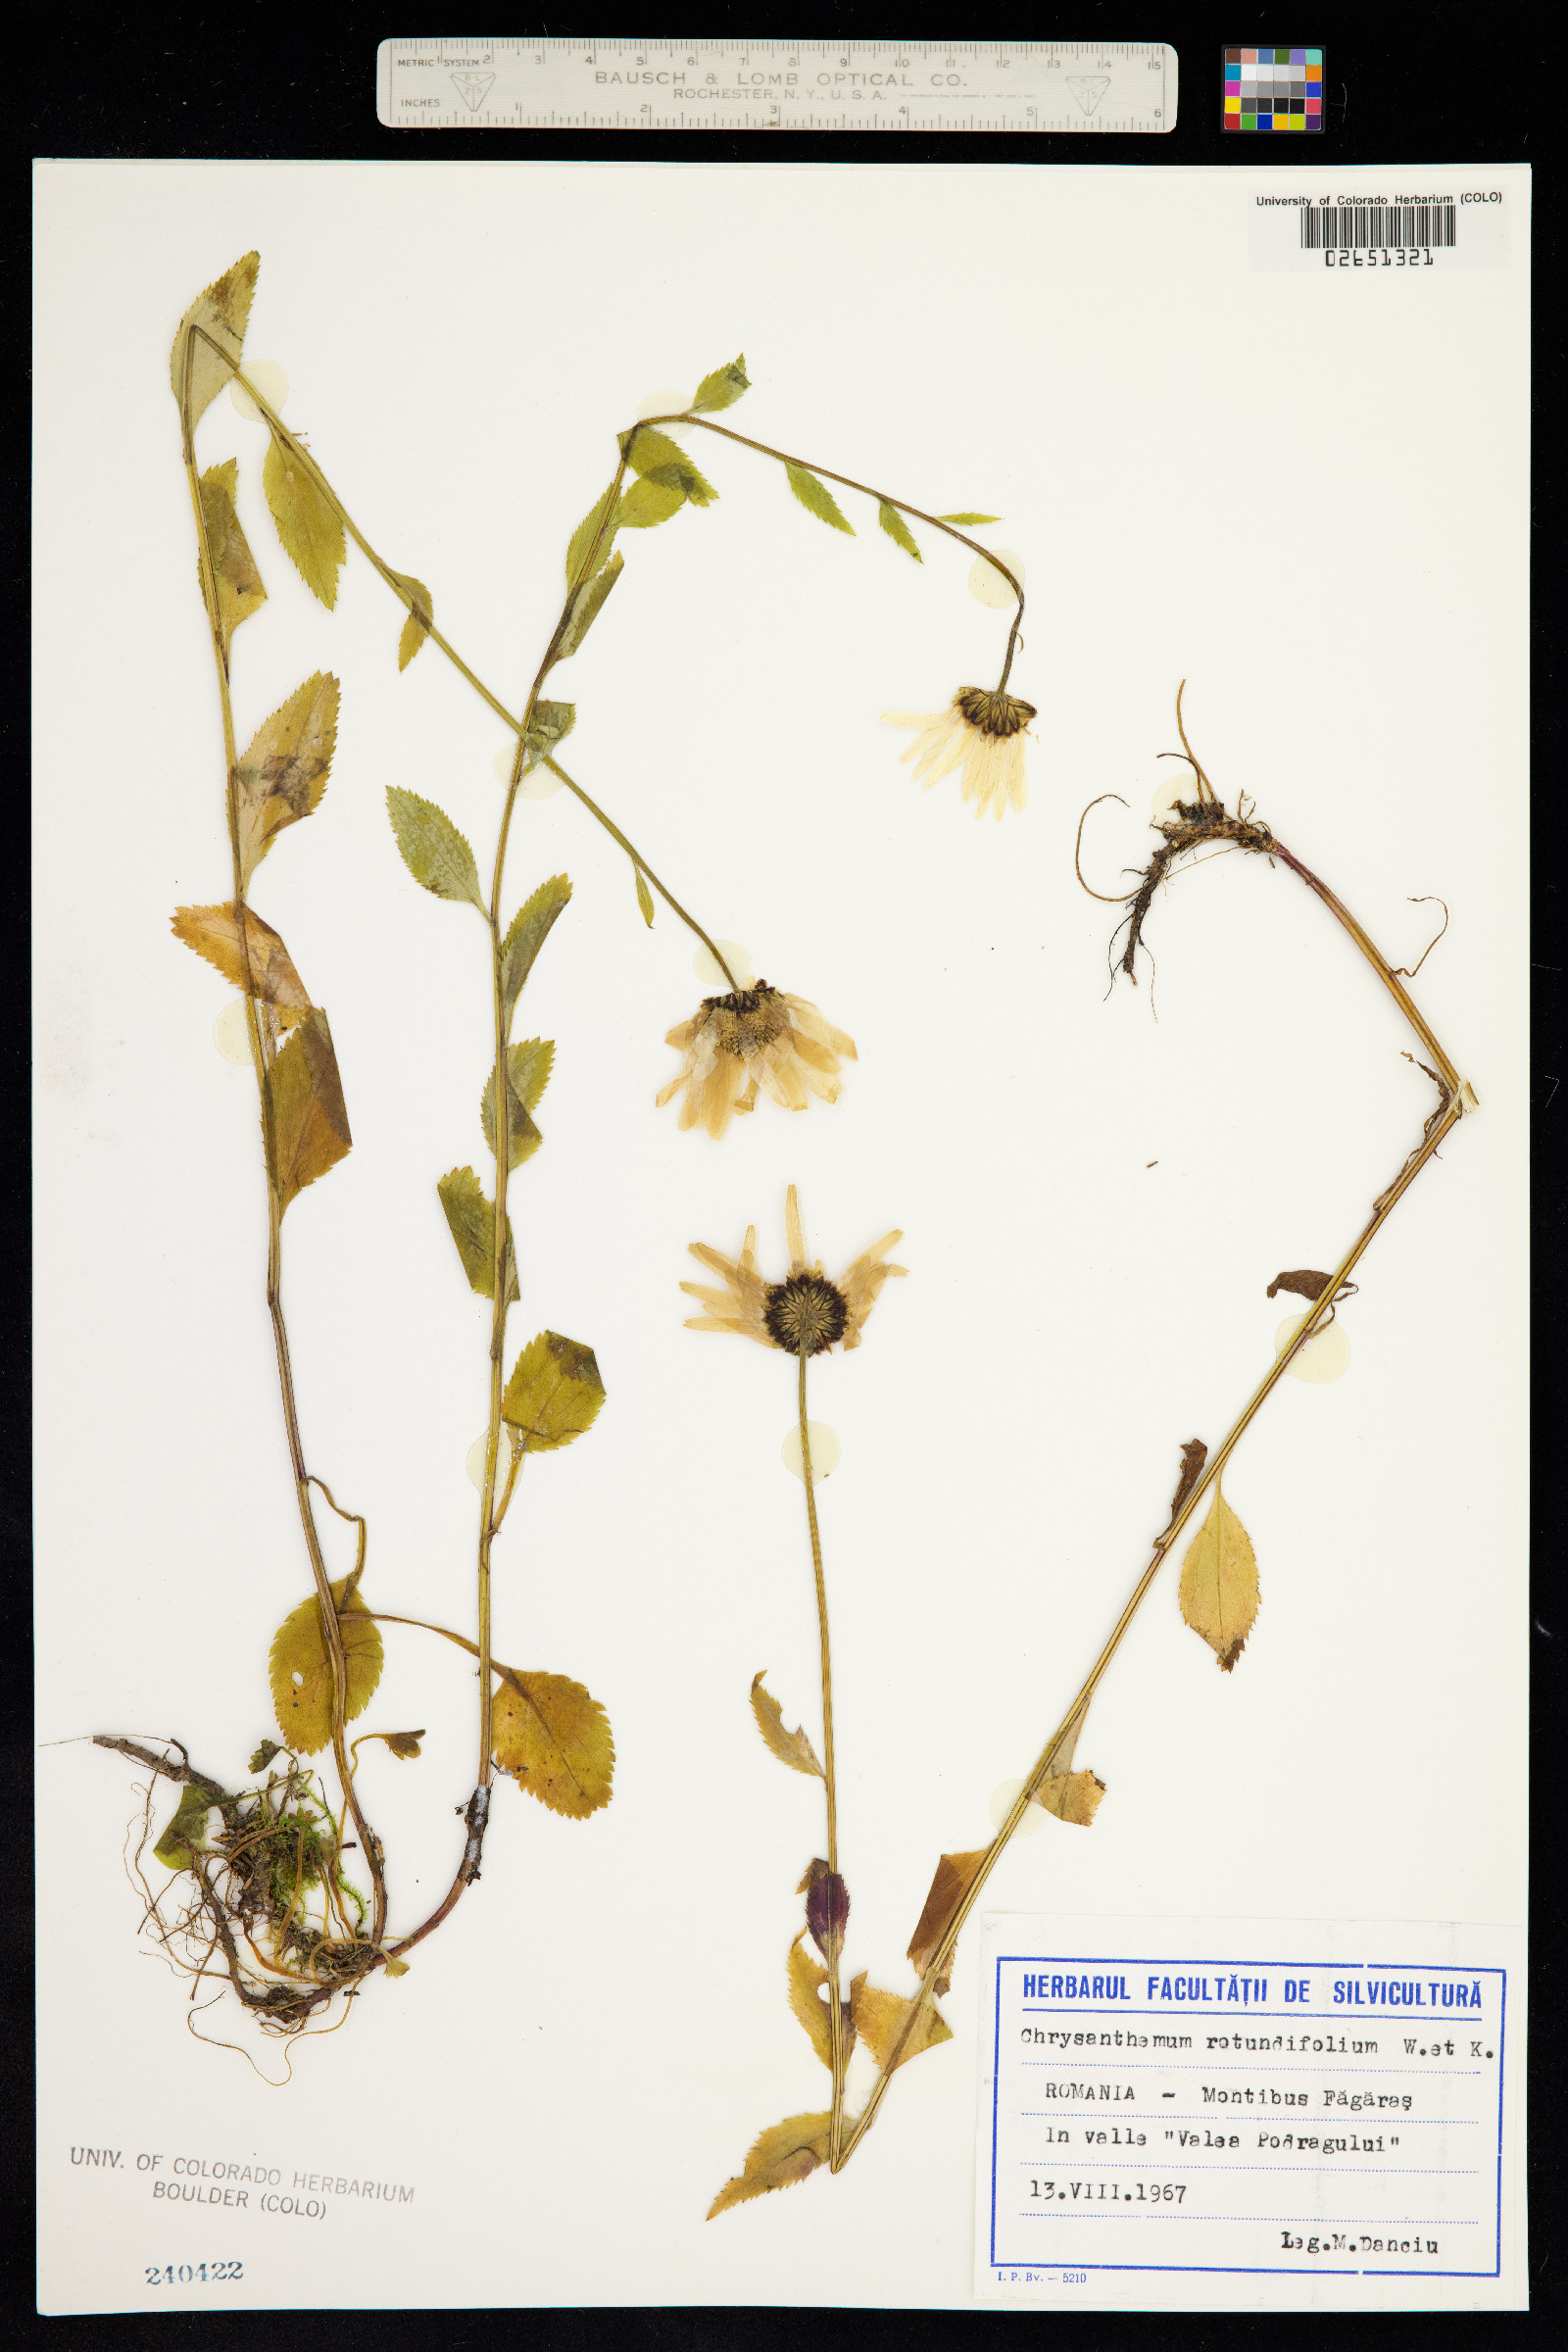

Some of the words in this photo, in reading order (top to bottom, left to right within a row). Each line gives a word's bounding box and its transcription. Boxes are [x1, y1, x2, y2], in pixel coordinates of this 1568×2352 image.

[595, 73, 686, 84] BAUSCH
[706, 73, 717, 84] &
[737, 73, 799, 84] LOMB
[817, 74, 912, 86] OPTICAL
[931, 74, 966, 86] CO.
[401, 98, 440, 107] INCHES
[784, 90, 800, 99] N.
[872, 90, 886, 100] A.
[899, 106, 906, 115] 4
[1026, 107, 1034, 116] 5
[1153, 109, 1162, 118] 6
[1256, 196, 1312, 208] University
[1319, 196, 1330, 205] of
[1338, 195, 1388, 205] Colorado
[1396, 195, 1453, 204] Herbarium
[1460, 192, 1502, 205] (COLO)
[1326, 249, 1433, 267] 02651321
[1023, 1974, 1131, 2000] HERBARUL
[1284, 1980, 1310, 2003] DE
[1333, 1980, 1482, 2008] SILVICULTURĂ
[1021, 2029, 1193, 2050] Chrysanthemum
[1206, 2034, 1378, 2053] rotundifolium
[1470, 2040, 1494, 2058] K.
[1046, 2083, 1136, 2100] ROMANIA
[1202, 2088, 1308, 2105] Montibus
[1046, 2128, 1069, 2143] In
[1085, 2129, 1147, 2146] valle
[1164, 2131, 1240, 2147] "Valea
[1257, 2132, 1399, 2153] Podragului"
[71, 2146, 124, 2169] UNIV.
[136, 2154, 164, 2171] OF
[173, 2157, 281, 2185] COLORADO
[293, 2172, 416, 2204] HERBARIUM
[153, 2180, 249, 2208] BOULDER
[261, 2192, 326, 2220] (COLO)
[1030, 2180, 1188, 2203] 13.VIII.1967
[145, 2261, 244, 2285] 240422
[1062, 2274, 1087, 2284] 5210
